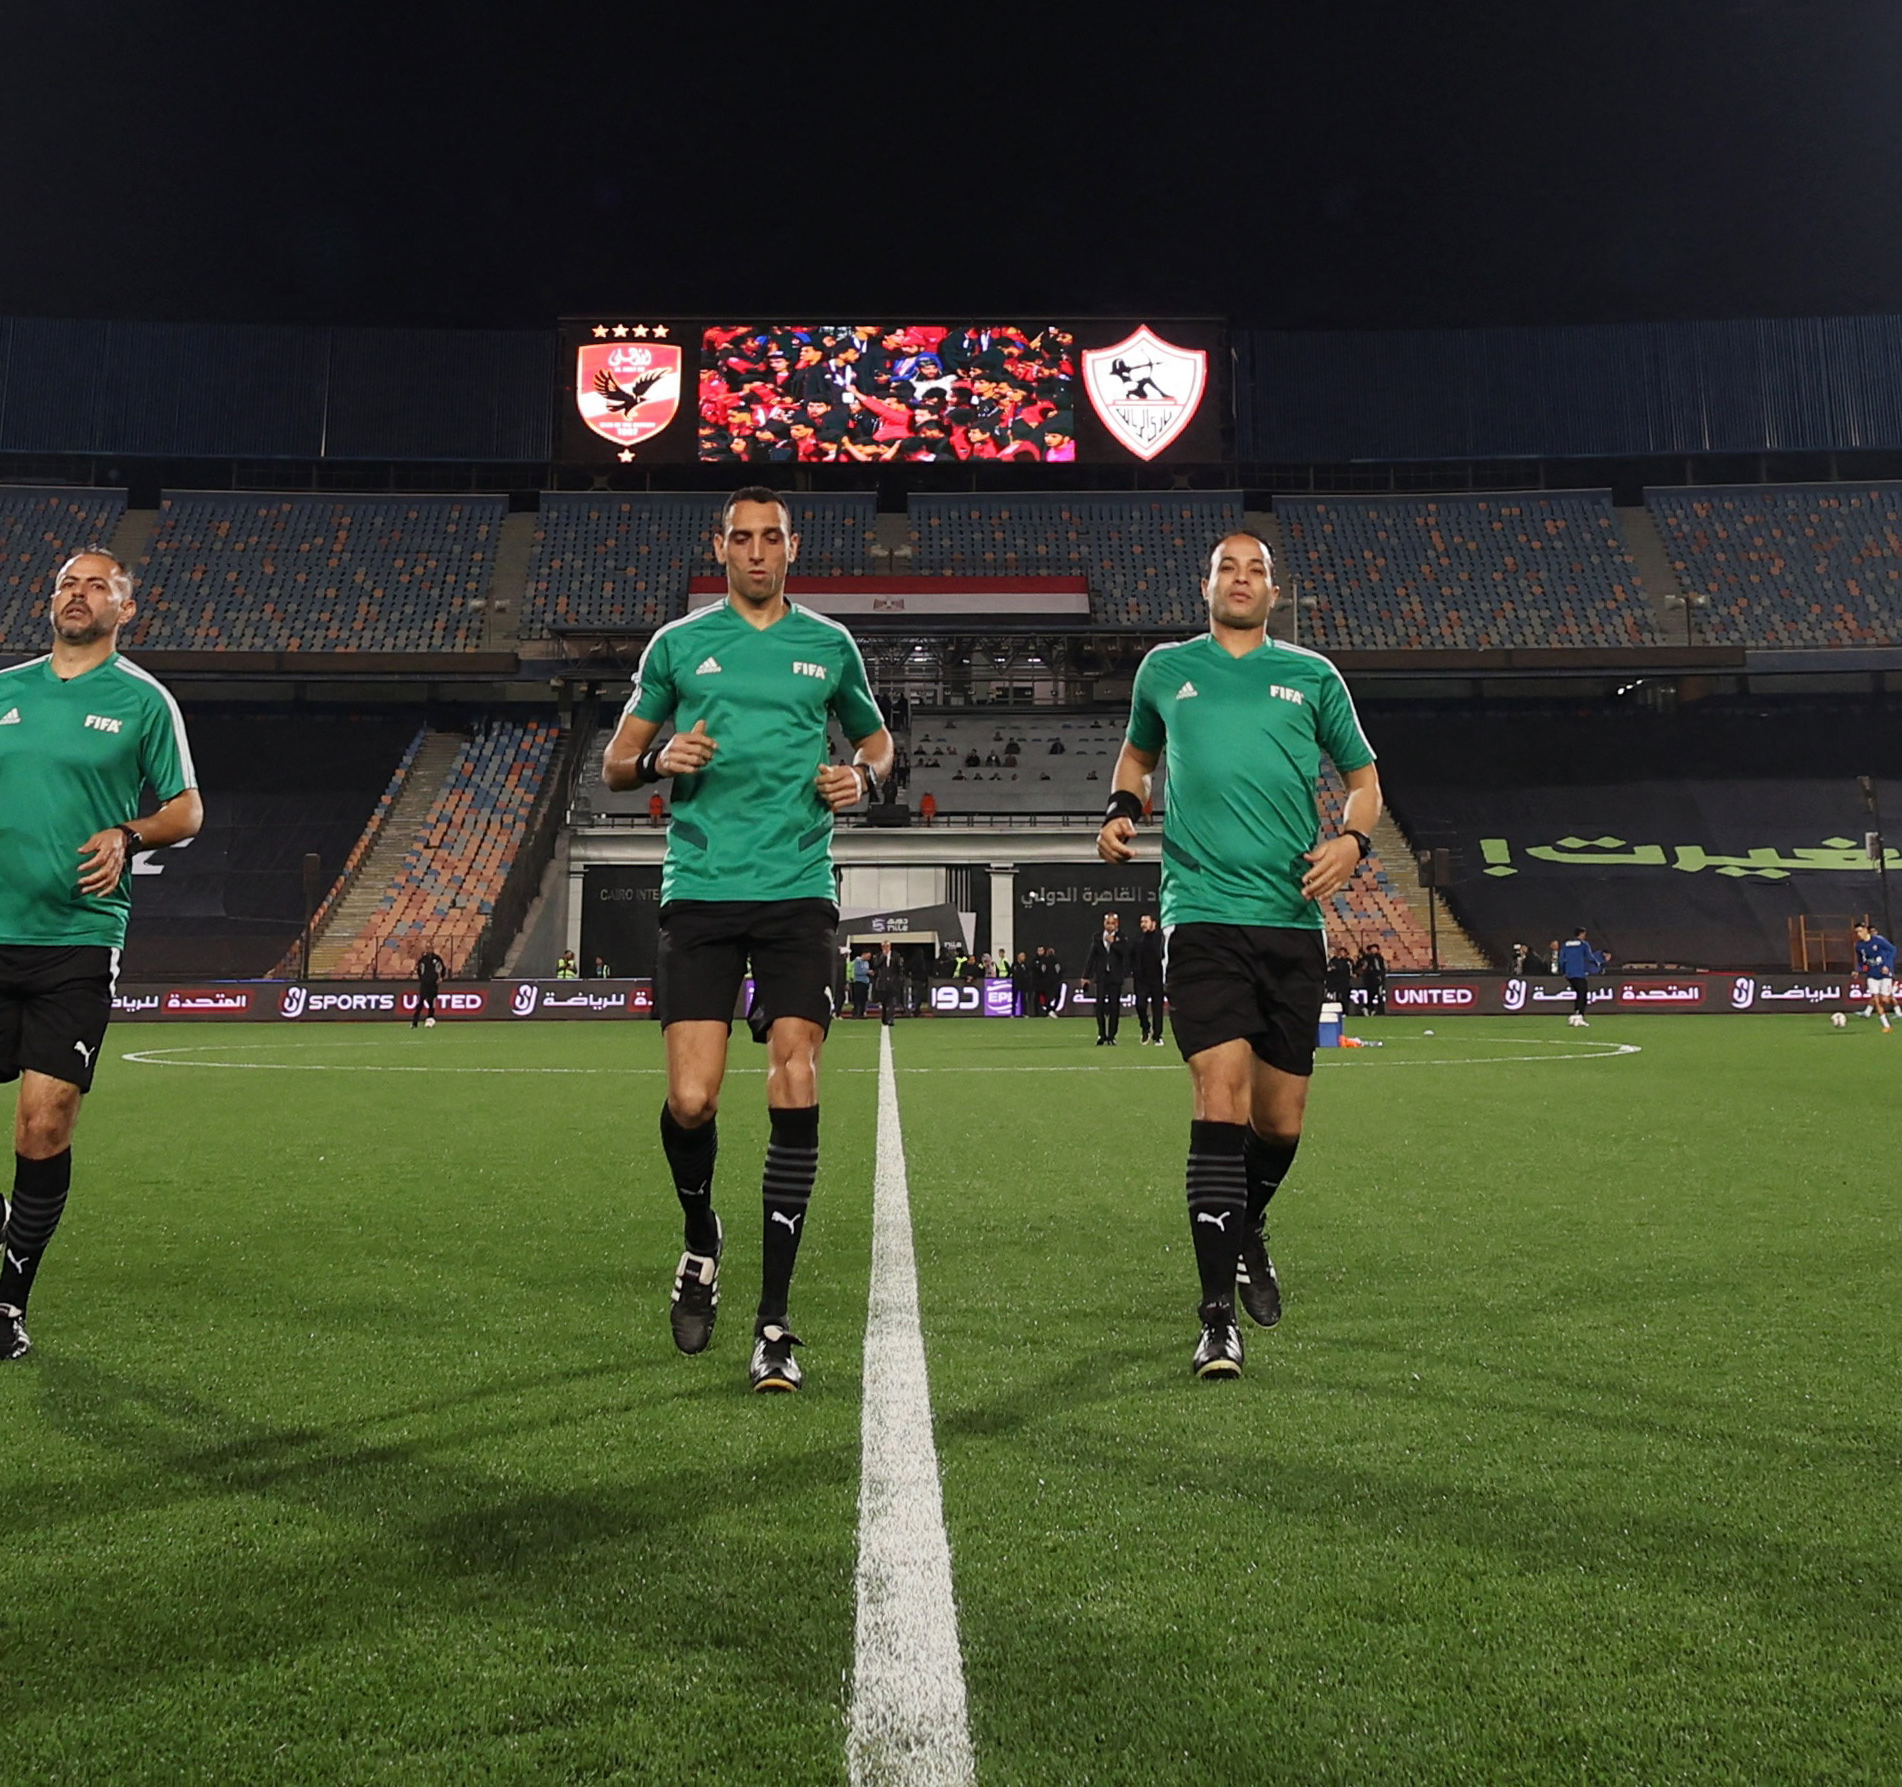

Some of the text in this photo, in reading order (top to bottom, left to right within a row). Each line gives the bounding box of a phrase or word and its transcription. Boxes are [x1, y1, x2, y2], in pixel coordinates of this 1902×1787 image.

[792, 661, 828, 680] FIFA
[1269, 684, 1305, 706] FIFA
[84, 714, 123, 733] FIFA
[167, 994, 247, 1008] المتحدة
[542, 992, 625, 1010] للرياضة
[1394, 989, 1473, 1004] UNITED
[1622, 986, 1699, 1000] المتحدة
[1760, 985, 1841, 1002] للرياضة
[309, 994, 395, 1010] SPORTS
